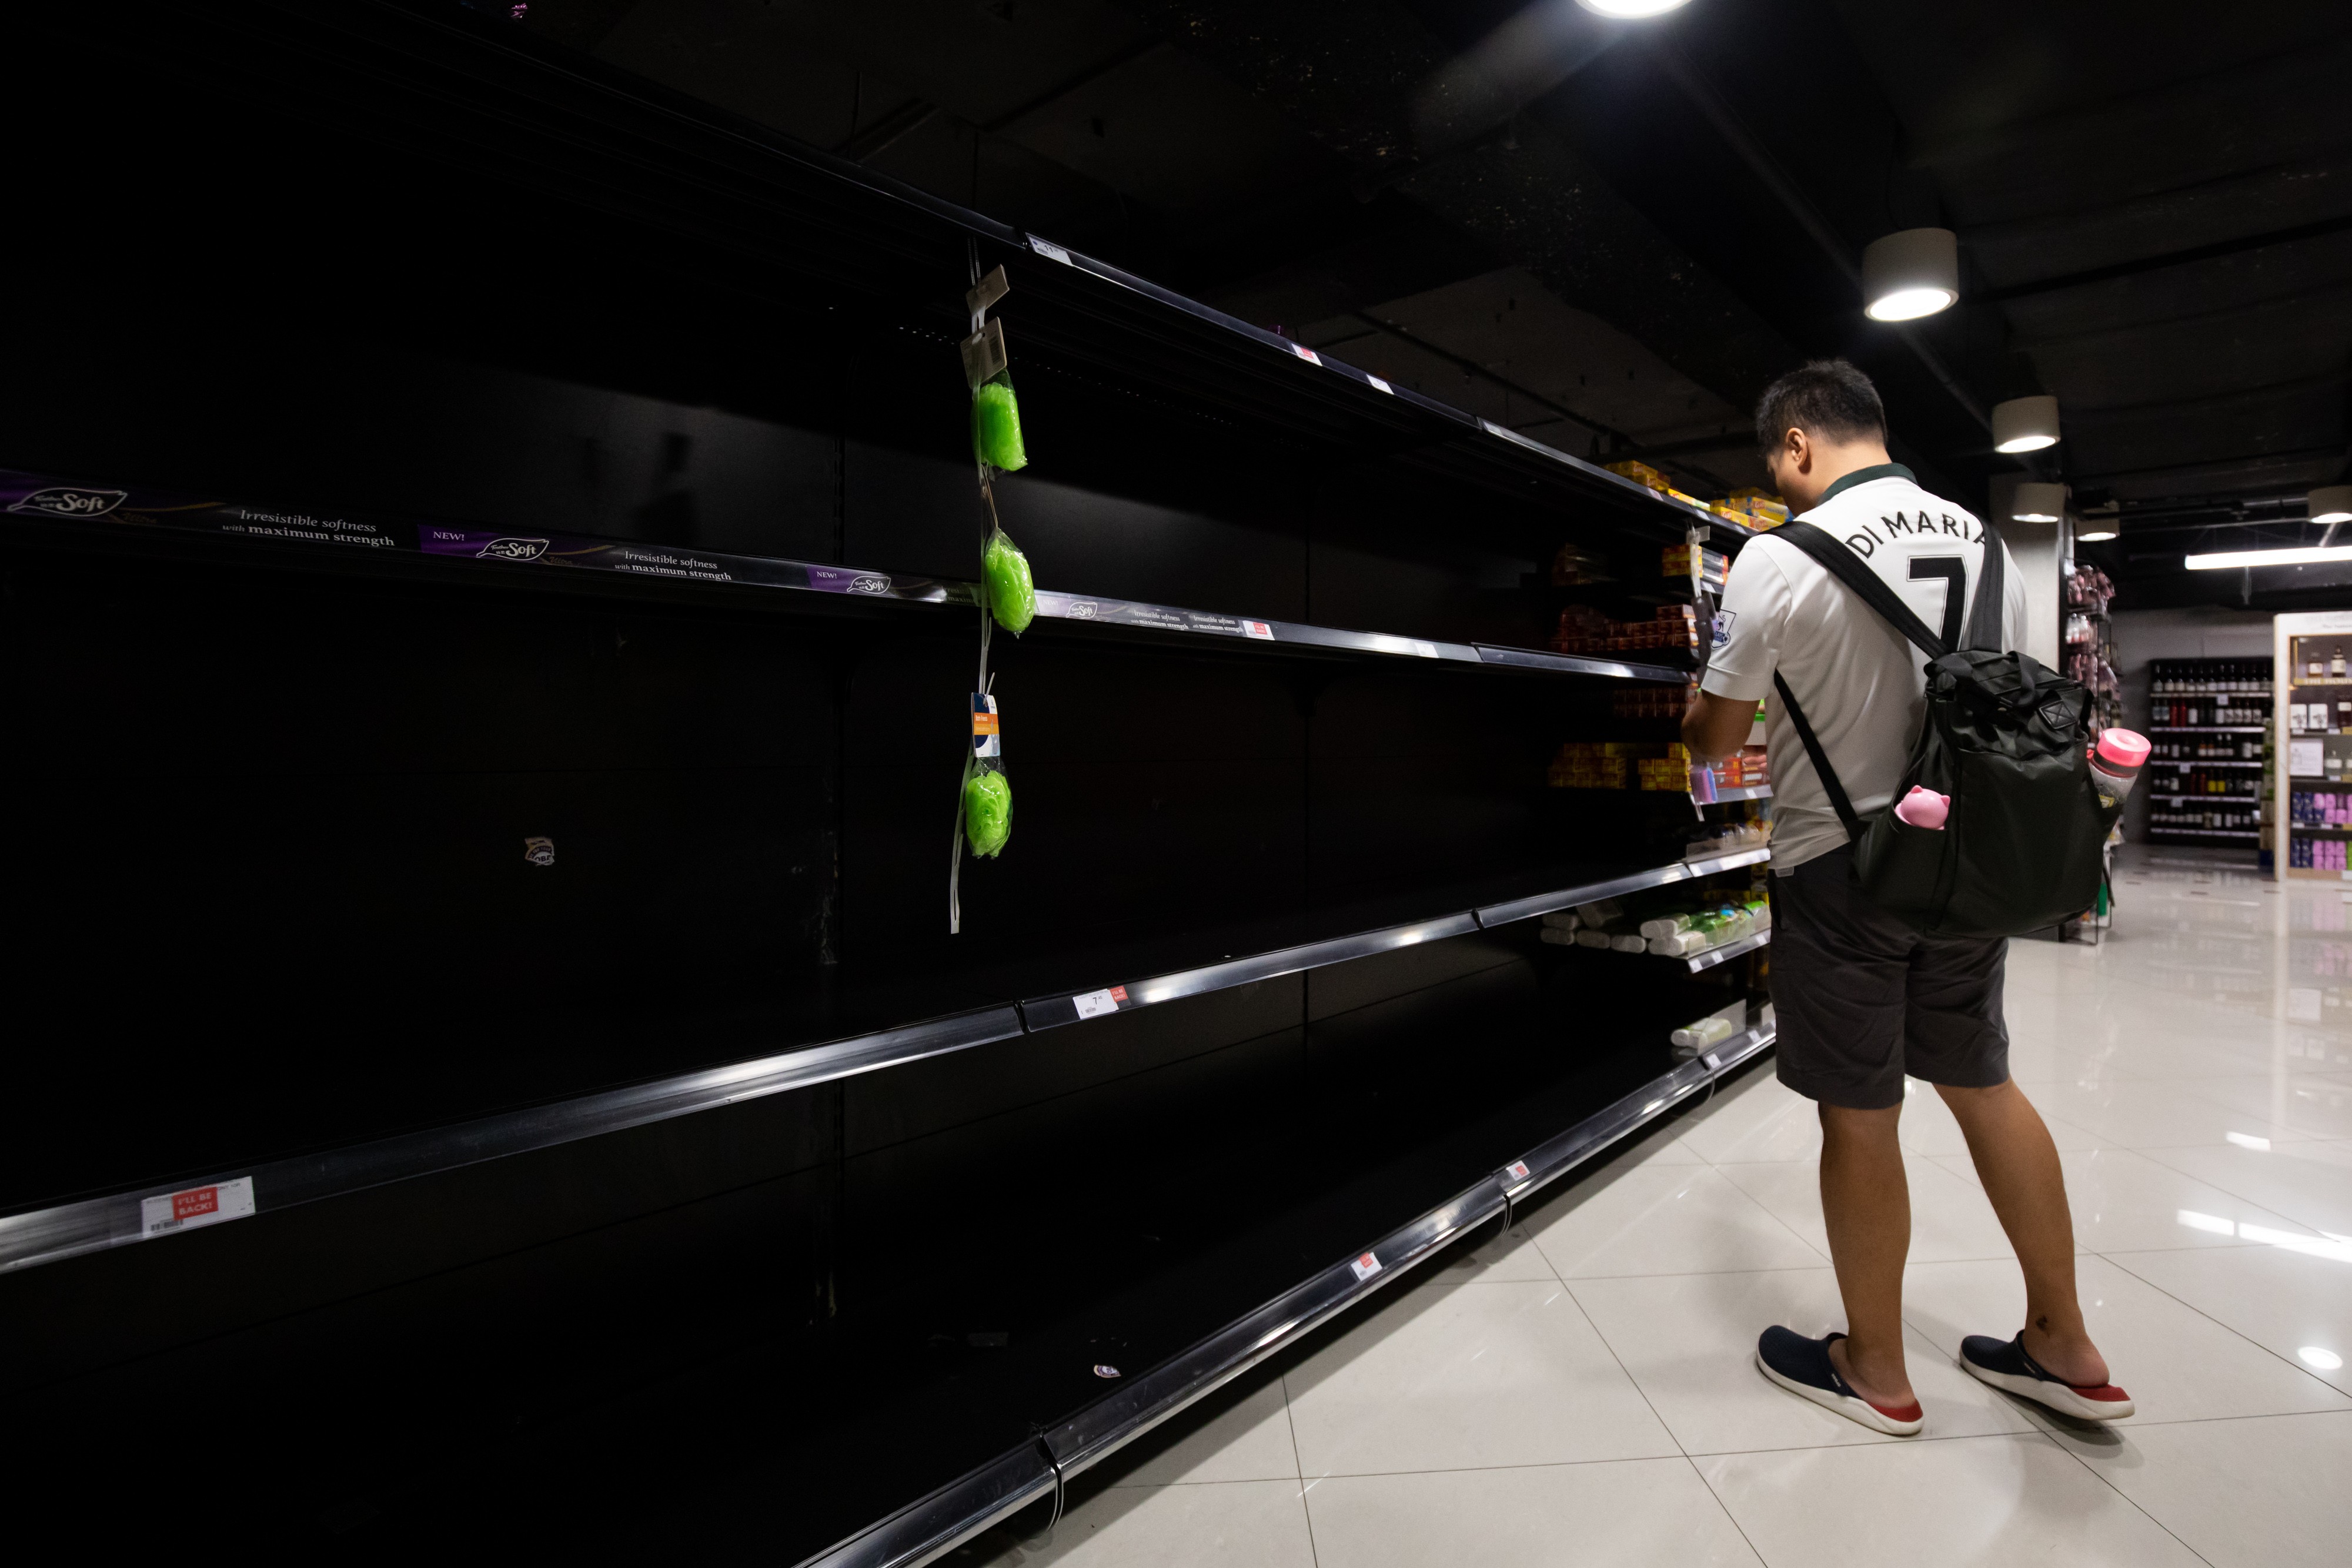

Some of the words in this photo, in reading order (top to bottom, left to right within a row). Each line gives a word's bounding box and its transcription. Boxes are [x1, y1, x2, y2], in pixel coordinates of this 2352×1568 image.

[56, 493, 106, 512] Soft
[240, 509, 318, 527] Irresistible
[322, 519, 377, 532] softness
[222, 524, 245, 532] with
[248, 526, 330, 540] maximum
[333, 533, 395, 547] strength
[433, 531, 465, 541] NEW!
[1845, 525, 1885, 559] DI
[506, 543, 537, 557] Soft
[625, 551, 677, 565] Irresistible
[680, 558, 717, 569] softness
[632, 564, 687, 576] maximum
[689, 570, 732, 581] strength
[865, 580, 884, 591] Soft
[1907, 554, 1969, 651] 7
[1079, 606, 1093, 616] Soft
[1134, 609, 1160, 619] Irresistible
[1161, 613, 1181, 622] softness
[1139, 619, 1167, 627] maximum
[1167, 622, 1189, 631] strength
[1194, 615, 1218, 624] Irresistible
[178, 1197, 196, 1205] I'LL
[178, 1202, 213, 1216] BACK!
